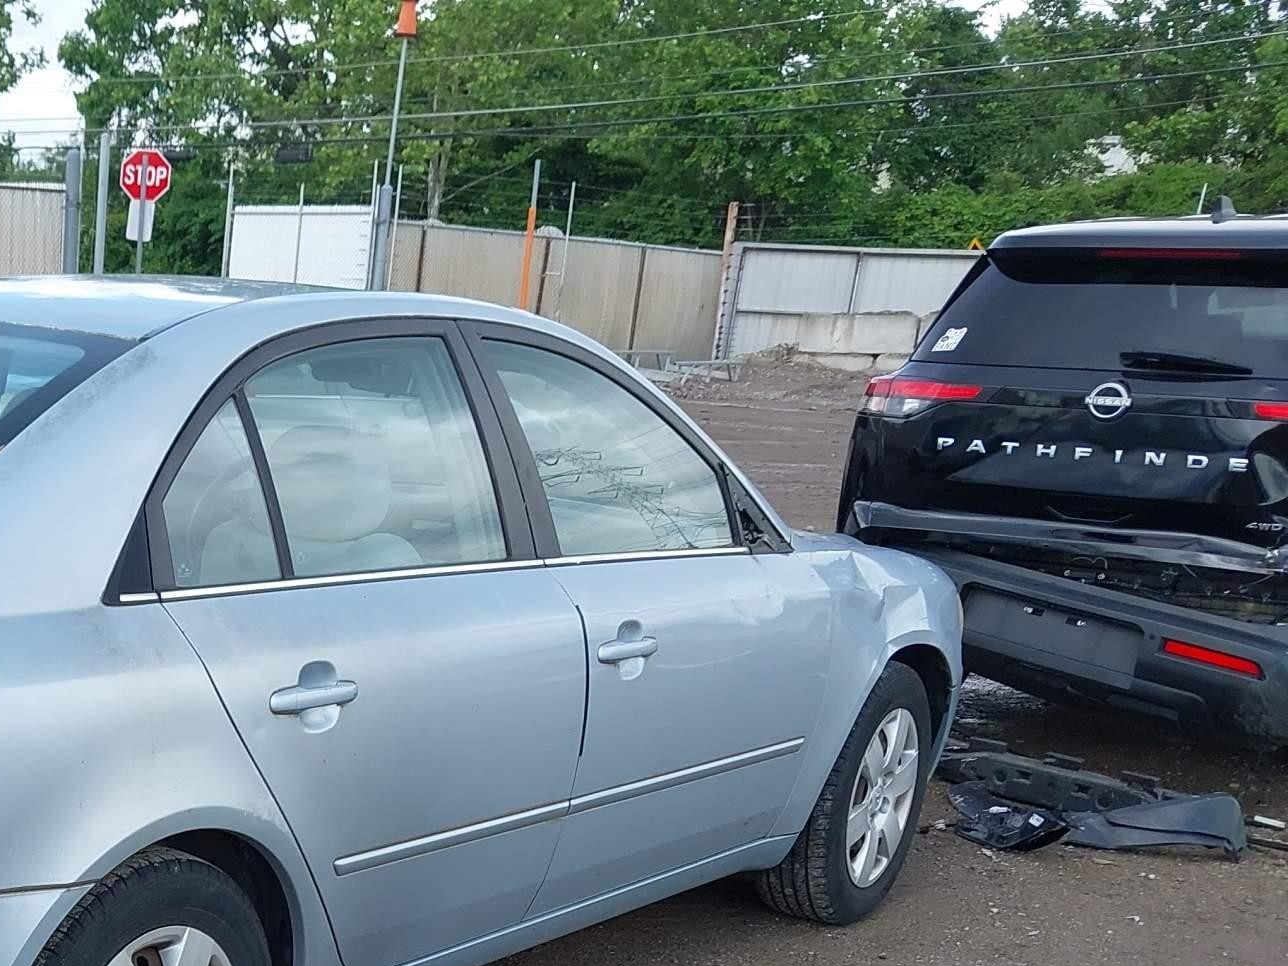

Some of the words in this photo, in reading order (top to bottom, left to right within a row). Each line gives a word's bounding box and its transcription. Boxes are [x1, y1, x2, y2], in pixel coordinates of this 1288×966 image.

[124, 164, 167, 187] STOP
[1084, 396, 1132, 407] NISSAN
[1246, 522, 1283, 531] 4WD
